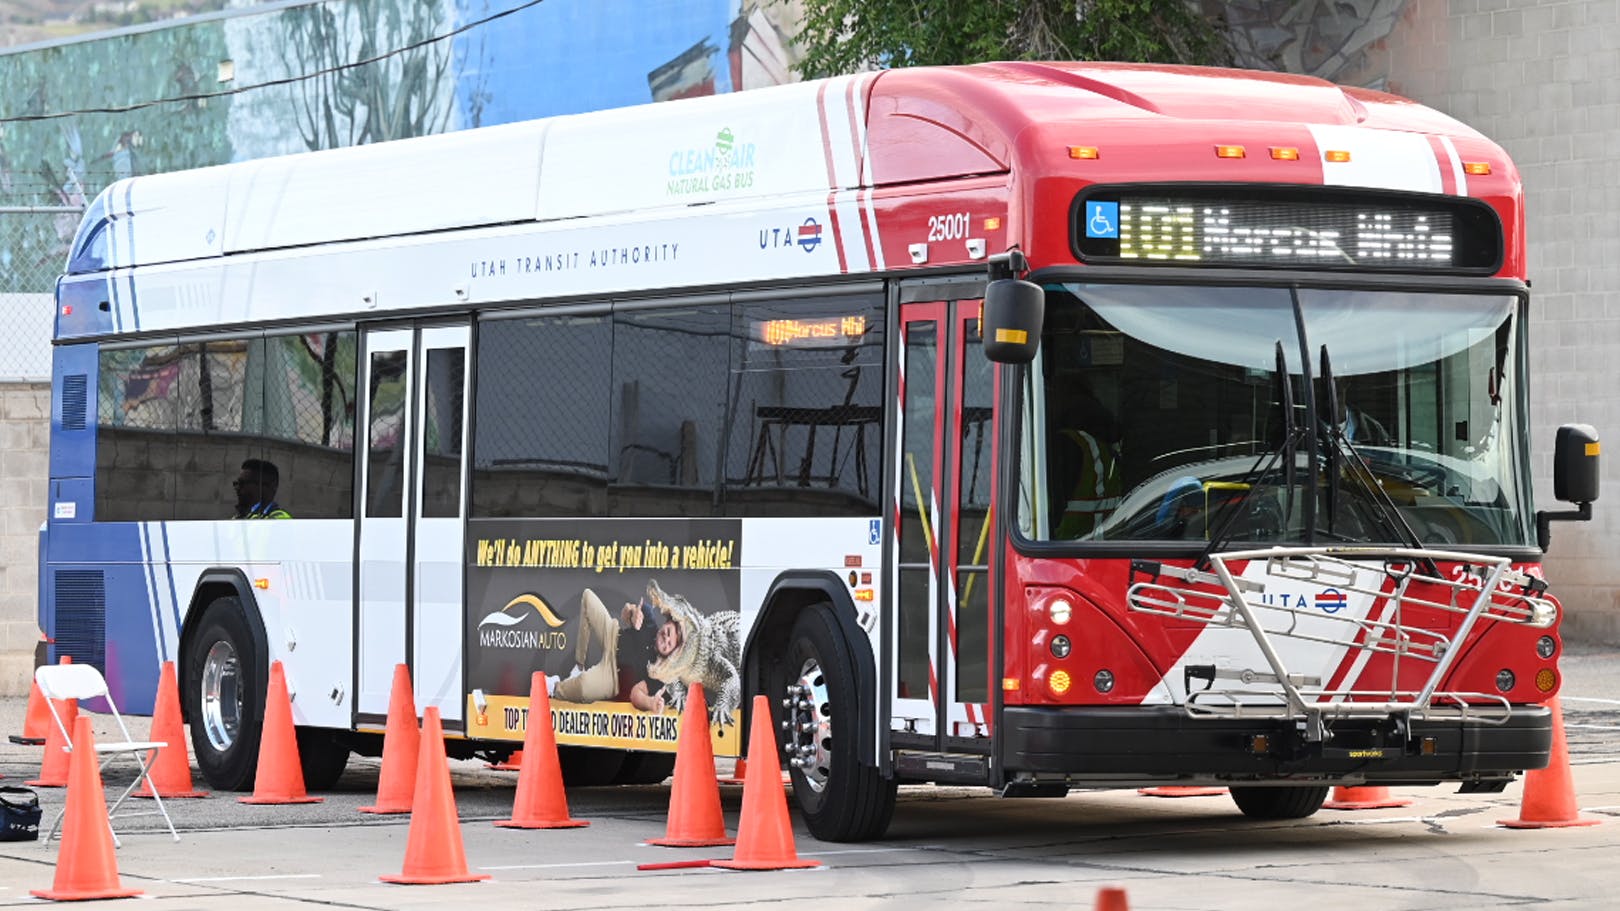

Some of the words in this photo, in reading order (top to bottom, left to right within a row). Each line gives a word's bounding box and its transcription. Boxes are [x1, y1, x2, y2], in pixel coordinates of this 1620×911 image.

[669, 147, 715, 177] CLEAN
[730, 143, 757, 169] AIR
[666, 176, 710, 196] NATURAL
[712, 174, 732, 192] GAS
[735, 170, 755, 189] BUS
[760, 227, 793, 249] UTA
[927, 212, 971, 242] 25001
[1203, 207, 1342, 256] Marcus
[1357, 213, 1453, 260] White
[471, 259, 506, 278] UTAH
[517, 252, 579, 273] TRANSIT
[590, 243, 679, 267] AUTHORITY
[477, 539, 505, 567] We'll
[507, 539, 521, 567] do
[522, 540, 580, 568] ANYTHING
[582, 541, 595, 568] to
[595, 541, 618, 573] get
[620, 545, 642, 573] you
[644, 539, 669, 569] into
[671, 545, 680, 569] a
[683, 540, 734, 570] vehicle!
[1262, 594, 1307, 608] UTA
[504, 707, 520, 730] TOP
[559, 711, 591, 735] DEALER
[592, 713, 609, 736] FOR
[611, 714, 634, 738] OVER
[636, 715, 646, 739] 26
[648, 716, 678, 741] YEARS
